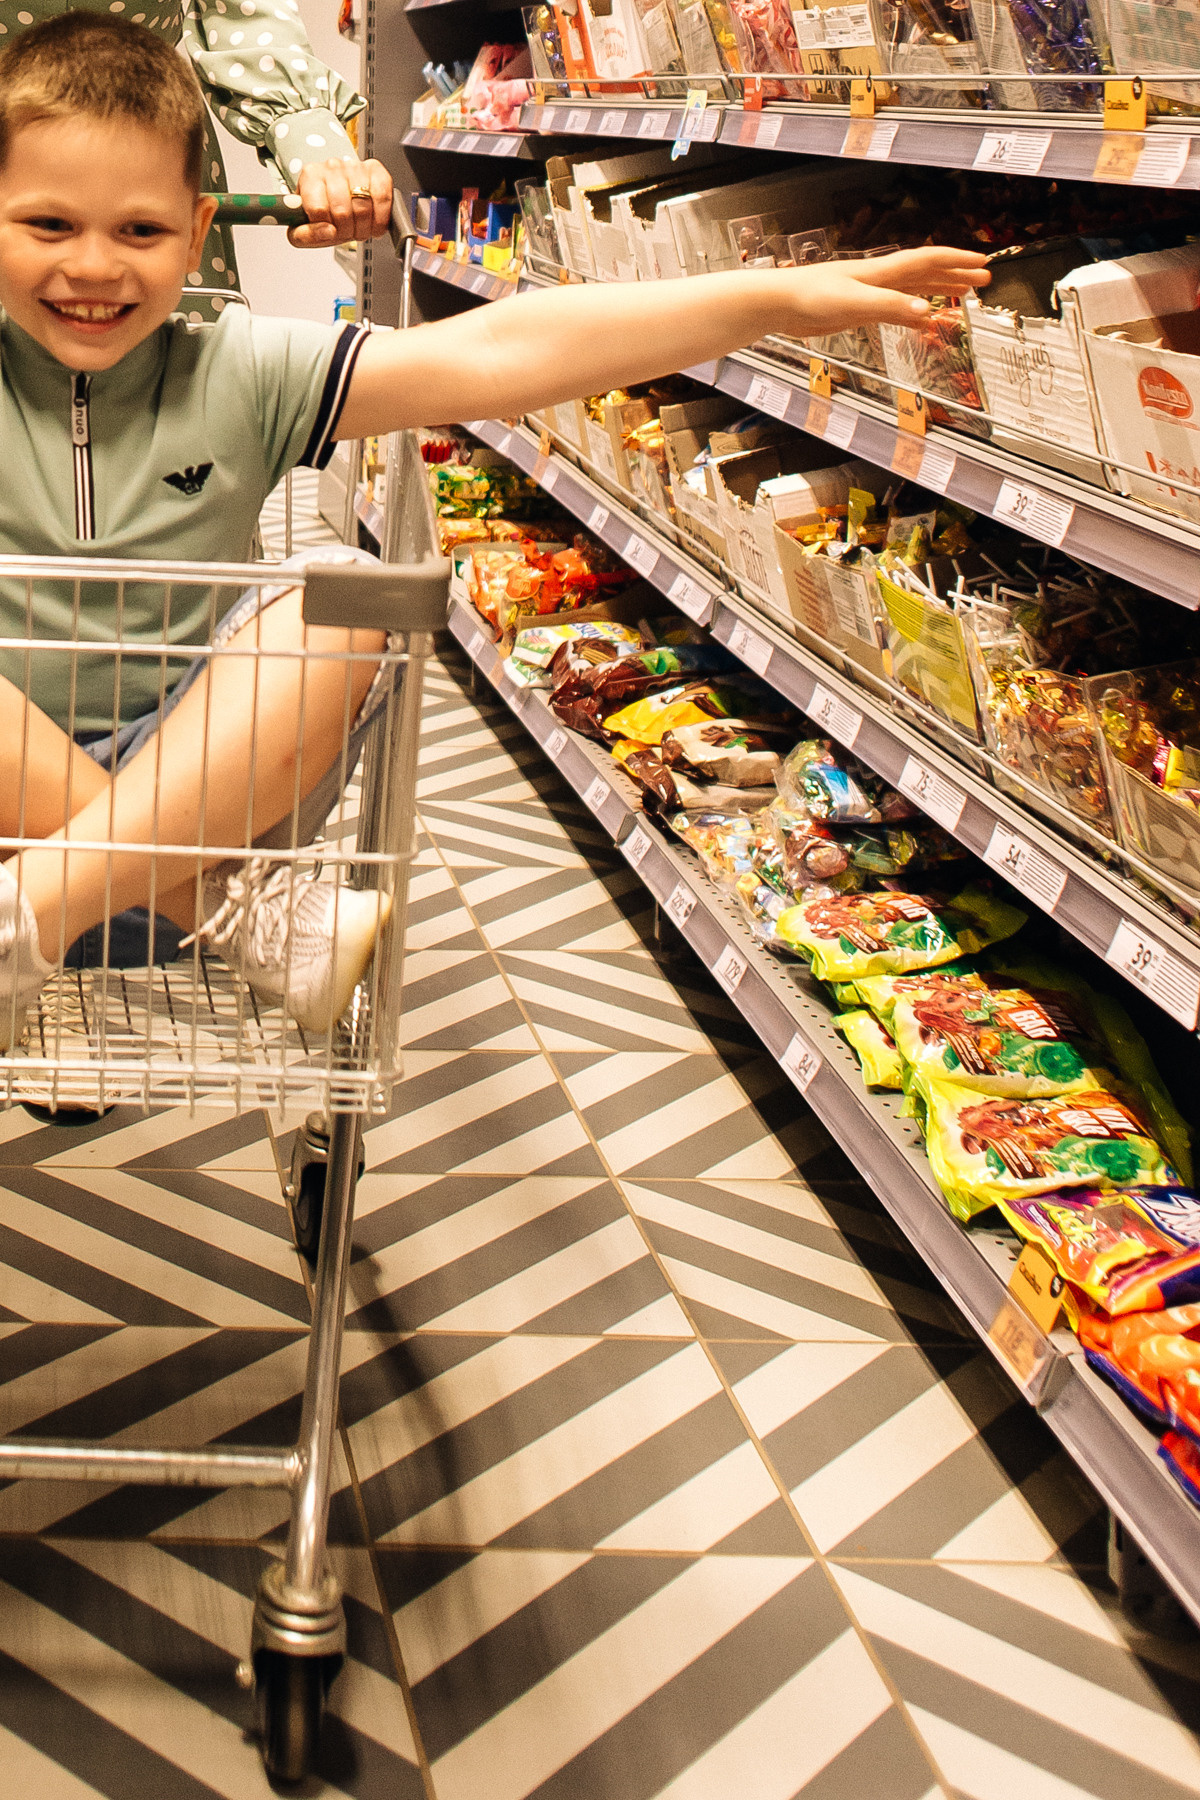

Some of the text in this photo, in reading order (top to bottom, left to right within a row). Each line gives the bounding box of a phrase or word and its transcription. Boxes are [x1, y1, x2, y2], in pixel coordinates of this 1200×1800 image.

[1012, 492, 1028, 515] 39
[1004, 842, 1022, 869] 54
[726, 957, 742, 980] 179
[1131, 941, 1153, 971] 39
